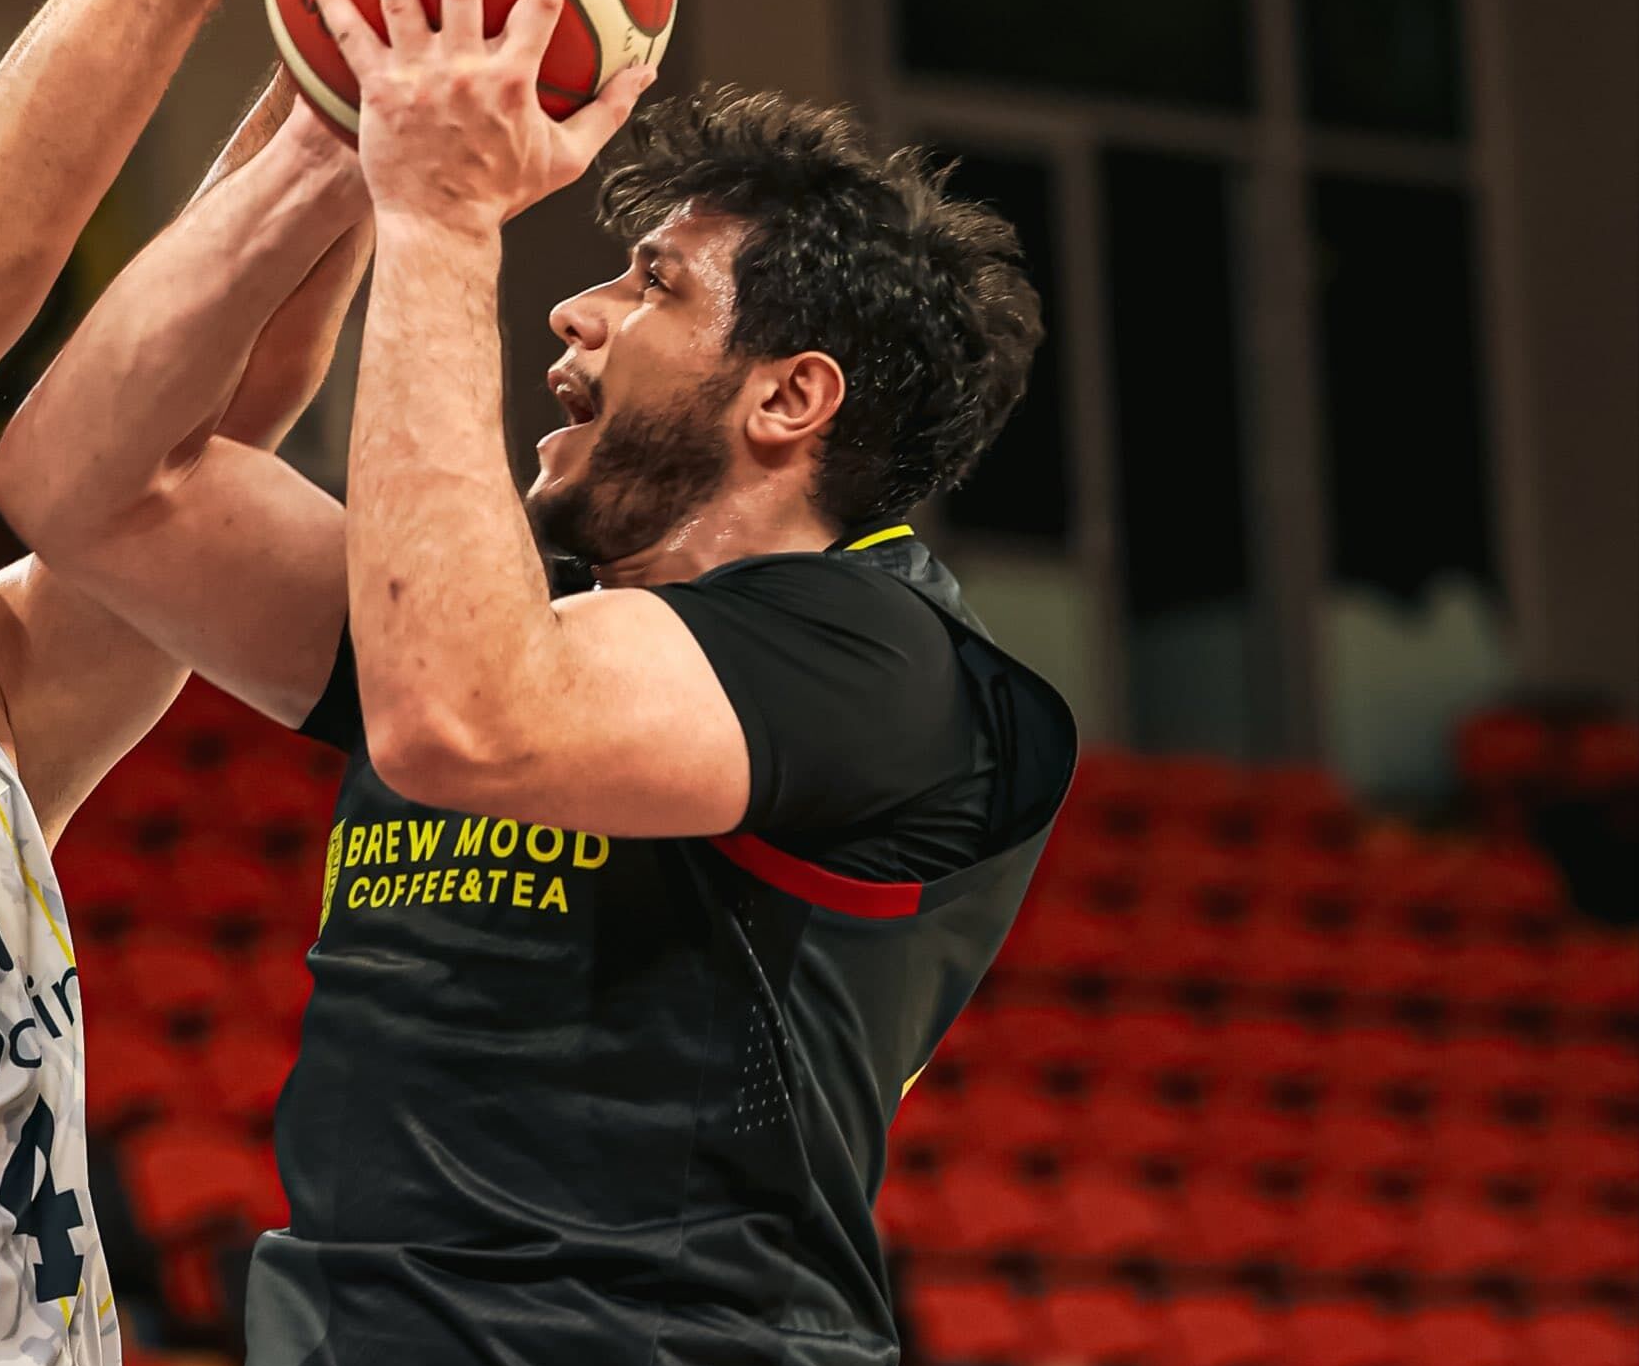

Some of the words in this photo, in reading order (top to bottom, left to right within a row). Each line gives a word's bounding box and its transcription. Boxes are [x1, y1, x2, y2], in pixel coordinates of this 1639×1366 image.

[344, 819, 446, 868] BREW
[453, 816, 610, 870] MOOD
[347, 868, 569, 914] COFFEE&TEA
